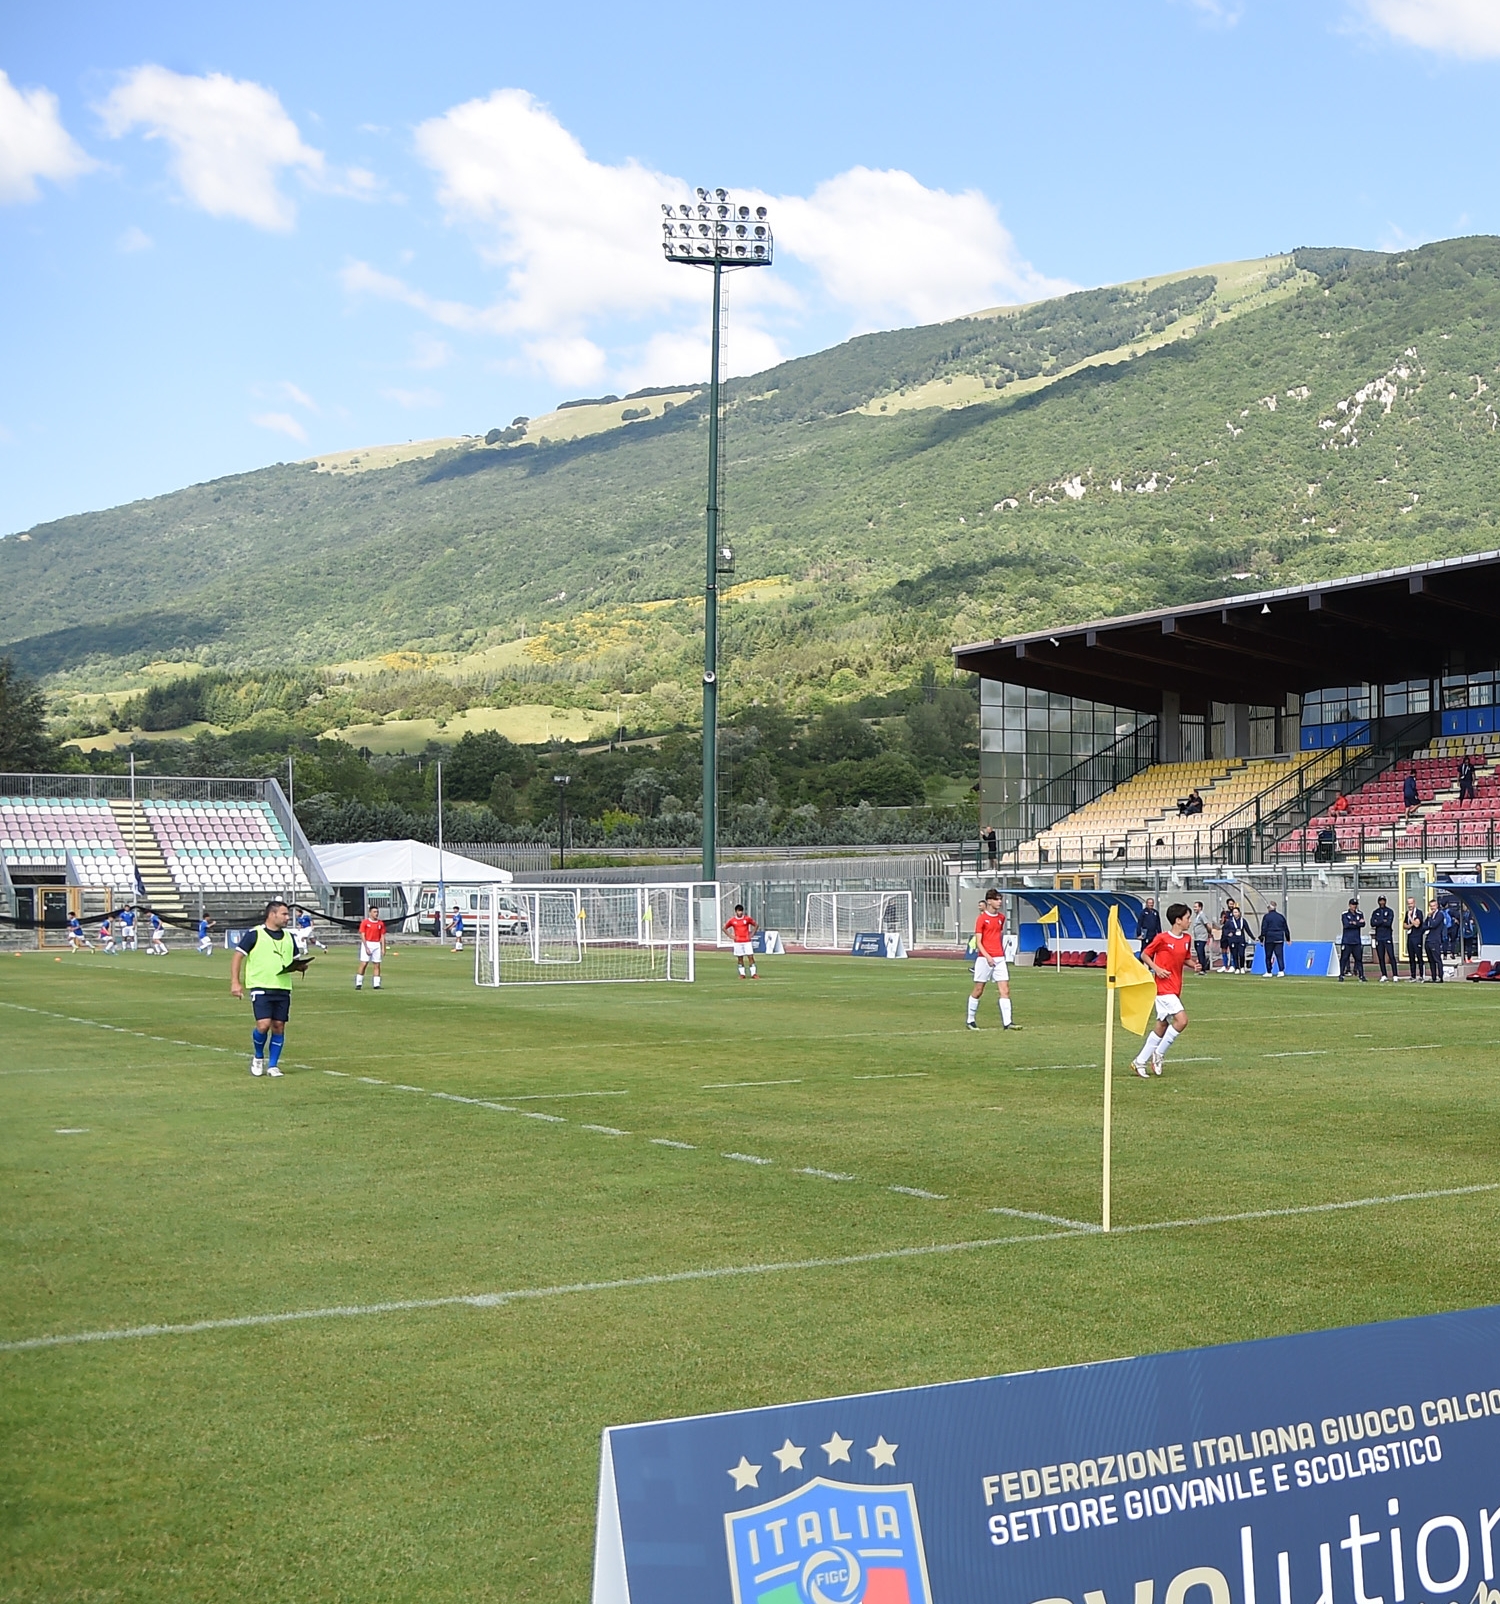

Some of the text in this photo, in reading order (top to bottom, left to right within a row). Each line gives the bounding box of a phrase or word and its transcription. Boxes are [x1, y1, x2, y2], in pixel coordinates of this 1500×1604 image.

[982, 1444, 1187, 1506] FEDERAZIONE
[1192, 1422, 1317, 1468] ITALIANA
[1320, 1404, 1416, 1445] GIUOCO
[988, 1434, 1443, 1545] SETTORE GIOVANILE E SCOLASTICO
[749, 1505, 900, 1564] ITALIA
[815, 1569, 849, 1585] FIGC
